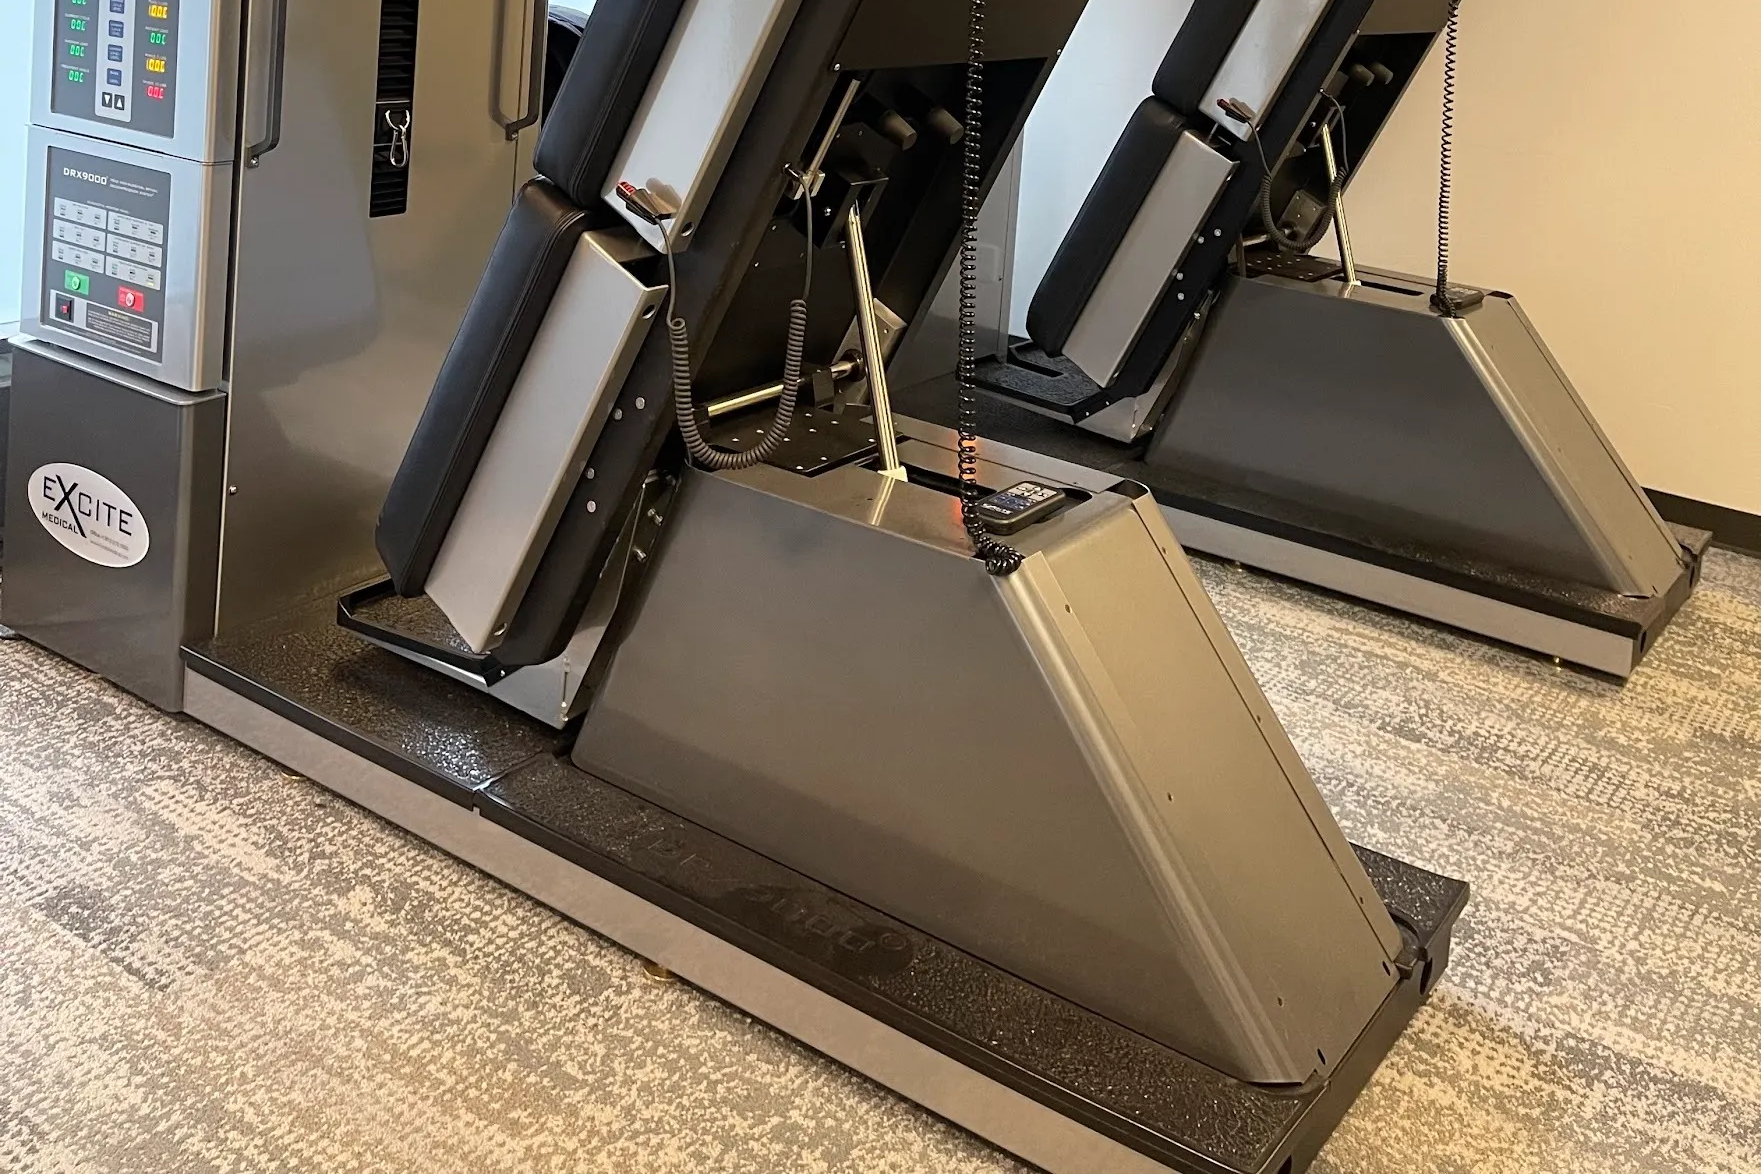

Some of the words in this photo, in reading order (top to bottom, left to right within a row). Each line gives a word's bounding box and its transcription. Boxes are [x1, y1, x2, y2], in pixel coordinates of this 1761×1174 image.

[63, 167, 107, 185] DRX9000
[43, 474, 133, 538] EXCITE
[42, 511, 79, 534] MEDICAL
